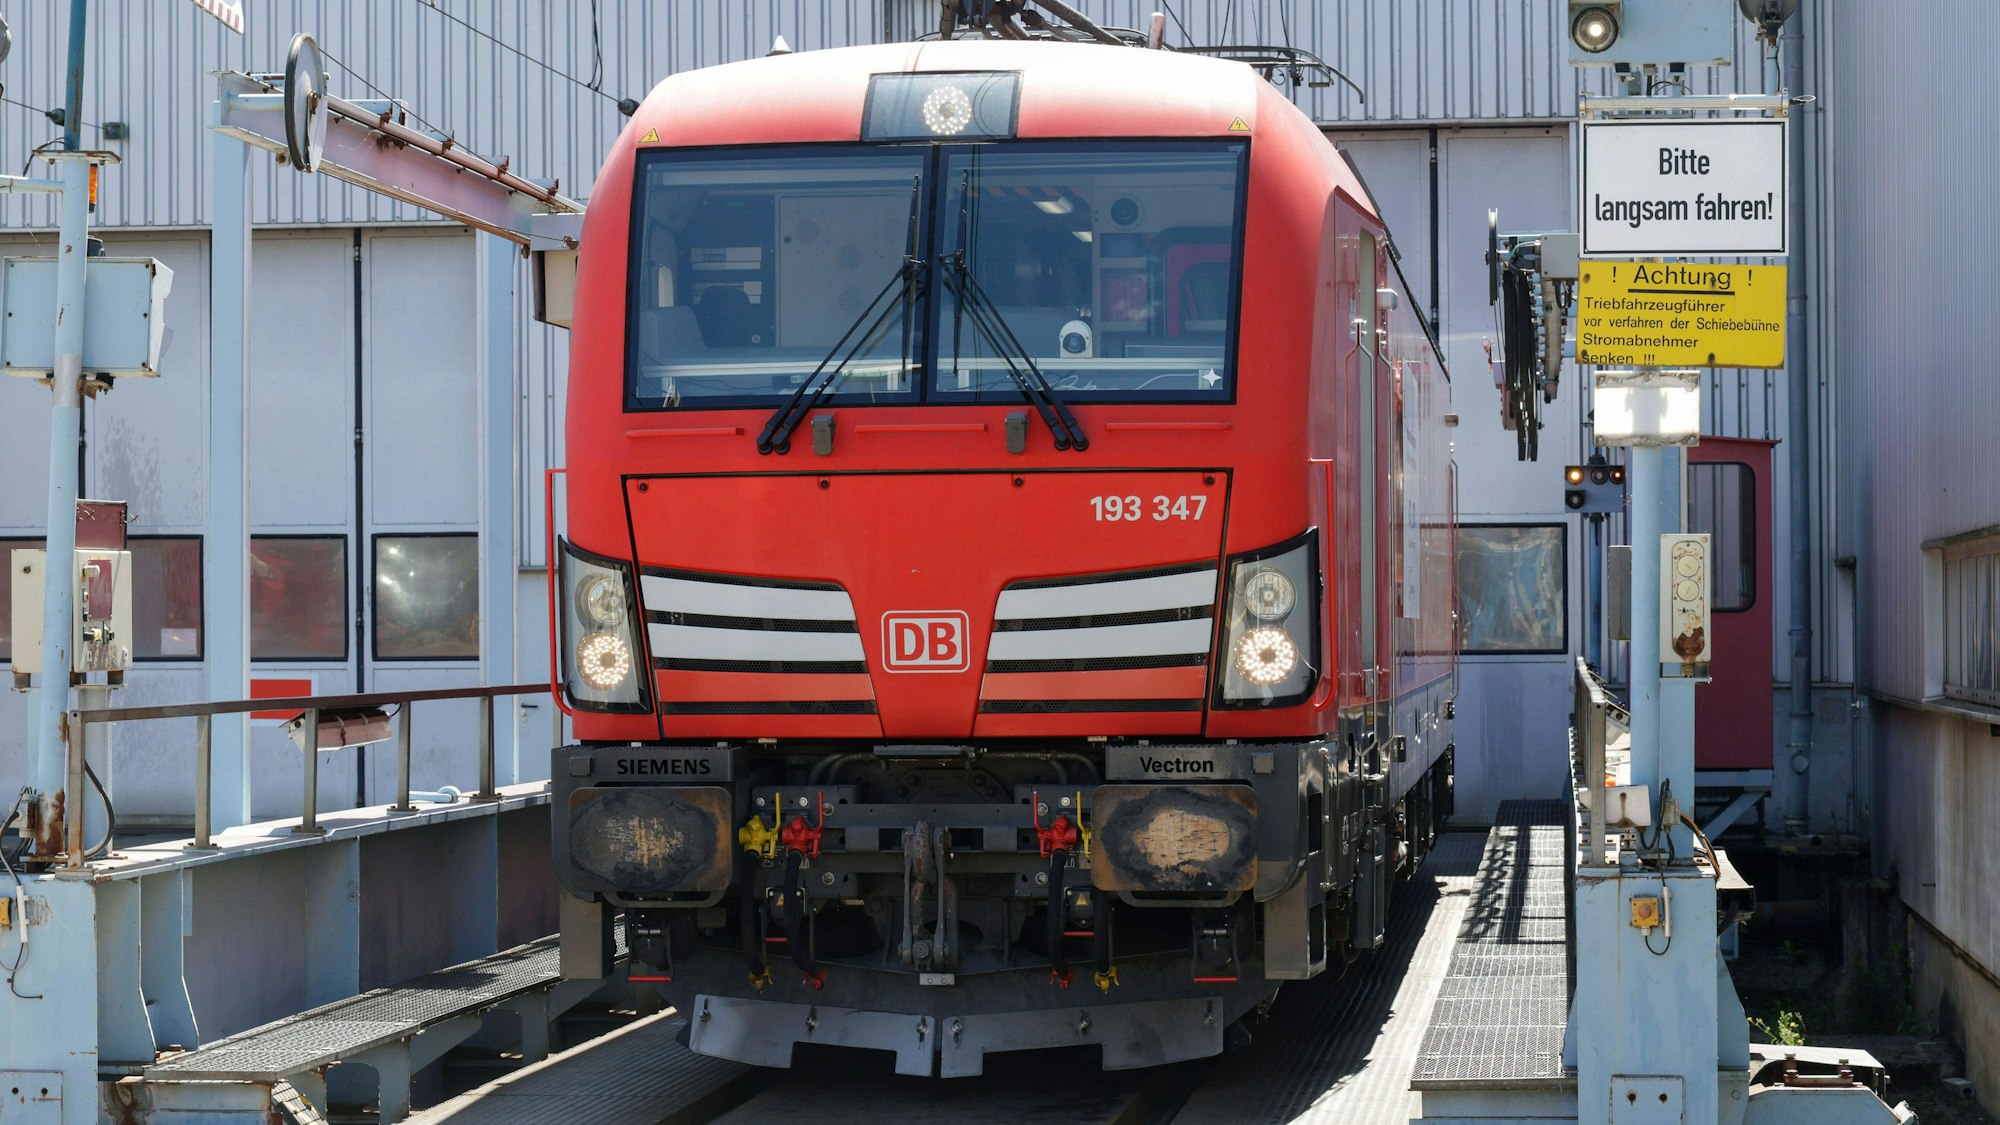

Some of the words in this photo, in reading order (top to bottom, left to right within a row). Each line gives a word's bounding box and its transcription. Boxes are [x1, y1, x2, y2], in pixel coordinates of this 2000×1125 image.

[1659, 147, 1711, 175] Bitte
[1595, 193, 1688, 229] langsam
[1695, 192, 1774, 221] fahren!
[1612, 266, 1617, 283] !
[1633, 265, 1731, 290] Achtung
[1747, 270, 1753, 286] !
[1584, 297, 1726, 313] Triebfahrzeugführer
[1584, 318, 1602, 327] vor
[1609, 316, 1663, 329] verfahren
[1670, 317, 1690, 330] der
[1696, 317, 1780, 332] Schiebebühne
[1583, 333, 1699, 349] Stromabnehmer
[1643, 354, 1655, 364] !!!
[1091, 496, 1141, 522] 193
[1152, 495, 1207, 521] 347
[895, 622, 957, 661] DB
[617, 759, 711, 774] SIEMENS
[1140, 757, 1214, 773] Vectron
